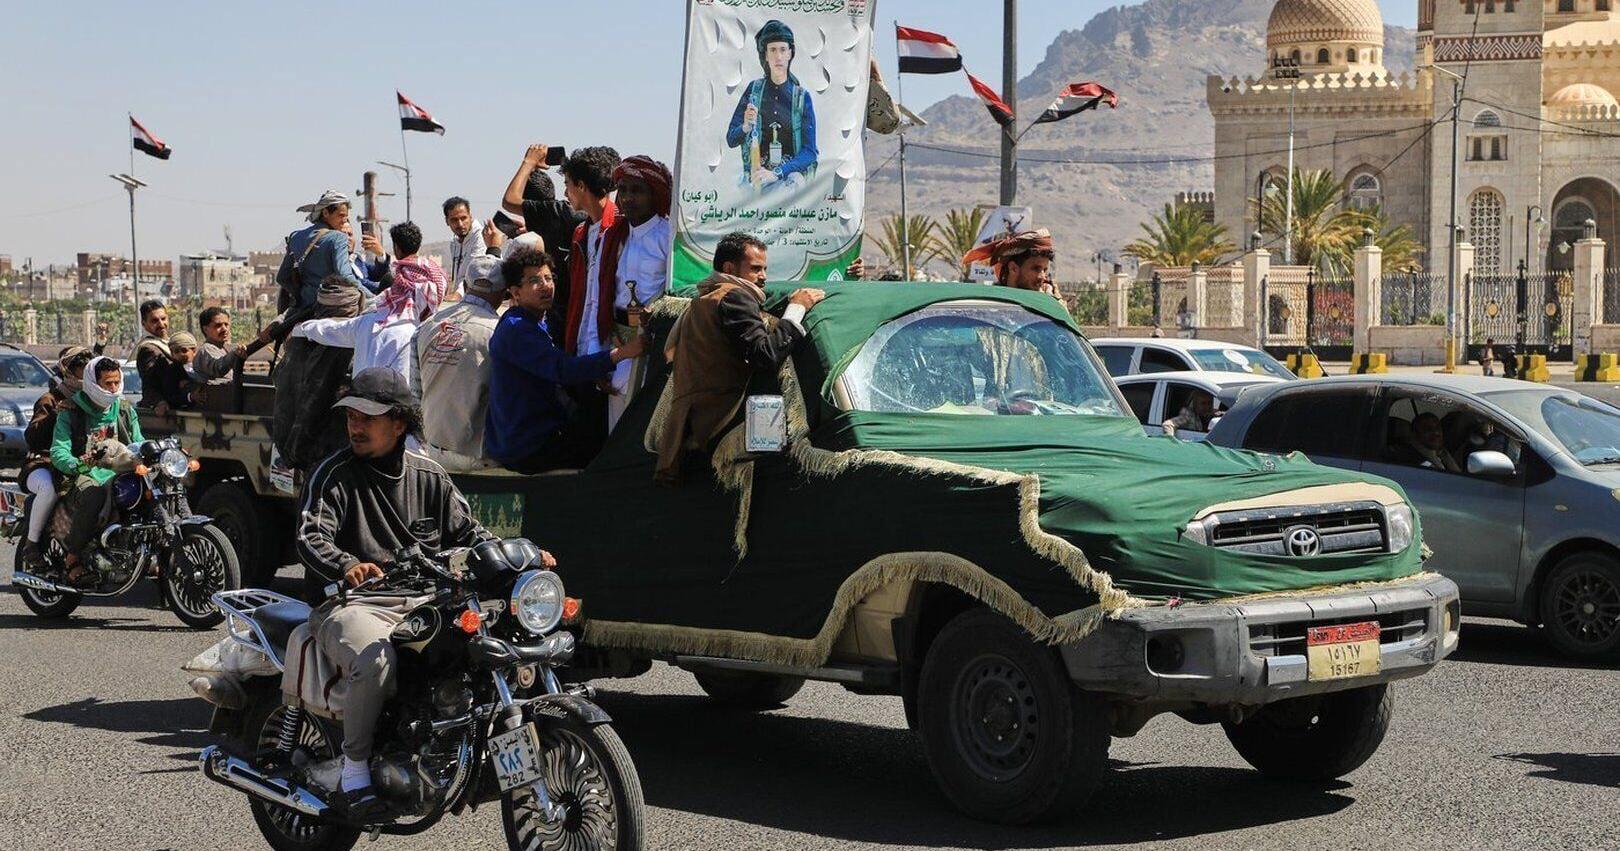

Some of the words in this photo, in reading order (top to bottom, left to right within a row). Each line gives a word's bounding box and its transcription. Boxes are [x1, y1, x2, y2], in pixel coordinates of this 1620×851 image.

[789, 208, 816, 221] عبدالله
[818, 209, 838, 222] مازن
[782, 237, 788, 245] 3
[1328, 645, 1361, 661] ١٥١٦٧
[1330, 662, 1360, 677] 15167
[499, 747, 523, 774] ٢٨٢
[506, 771, 525, 786] 282
